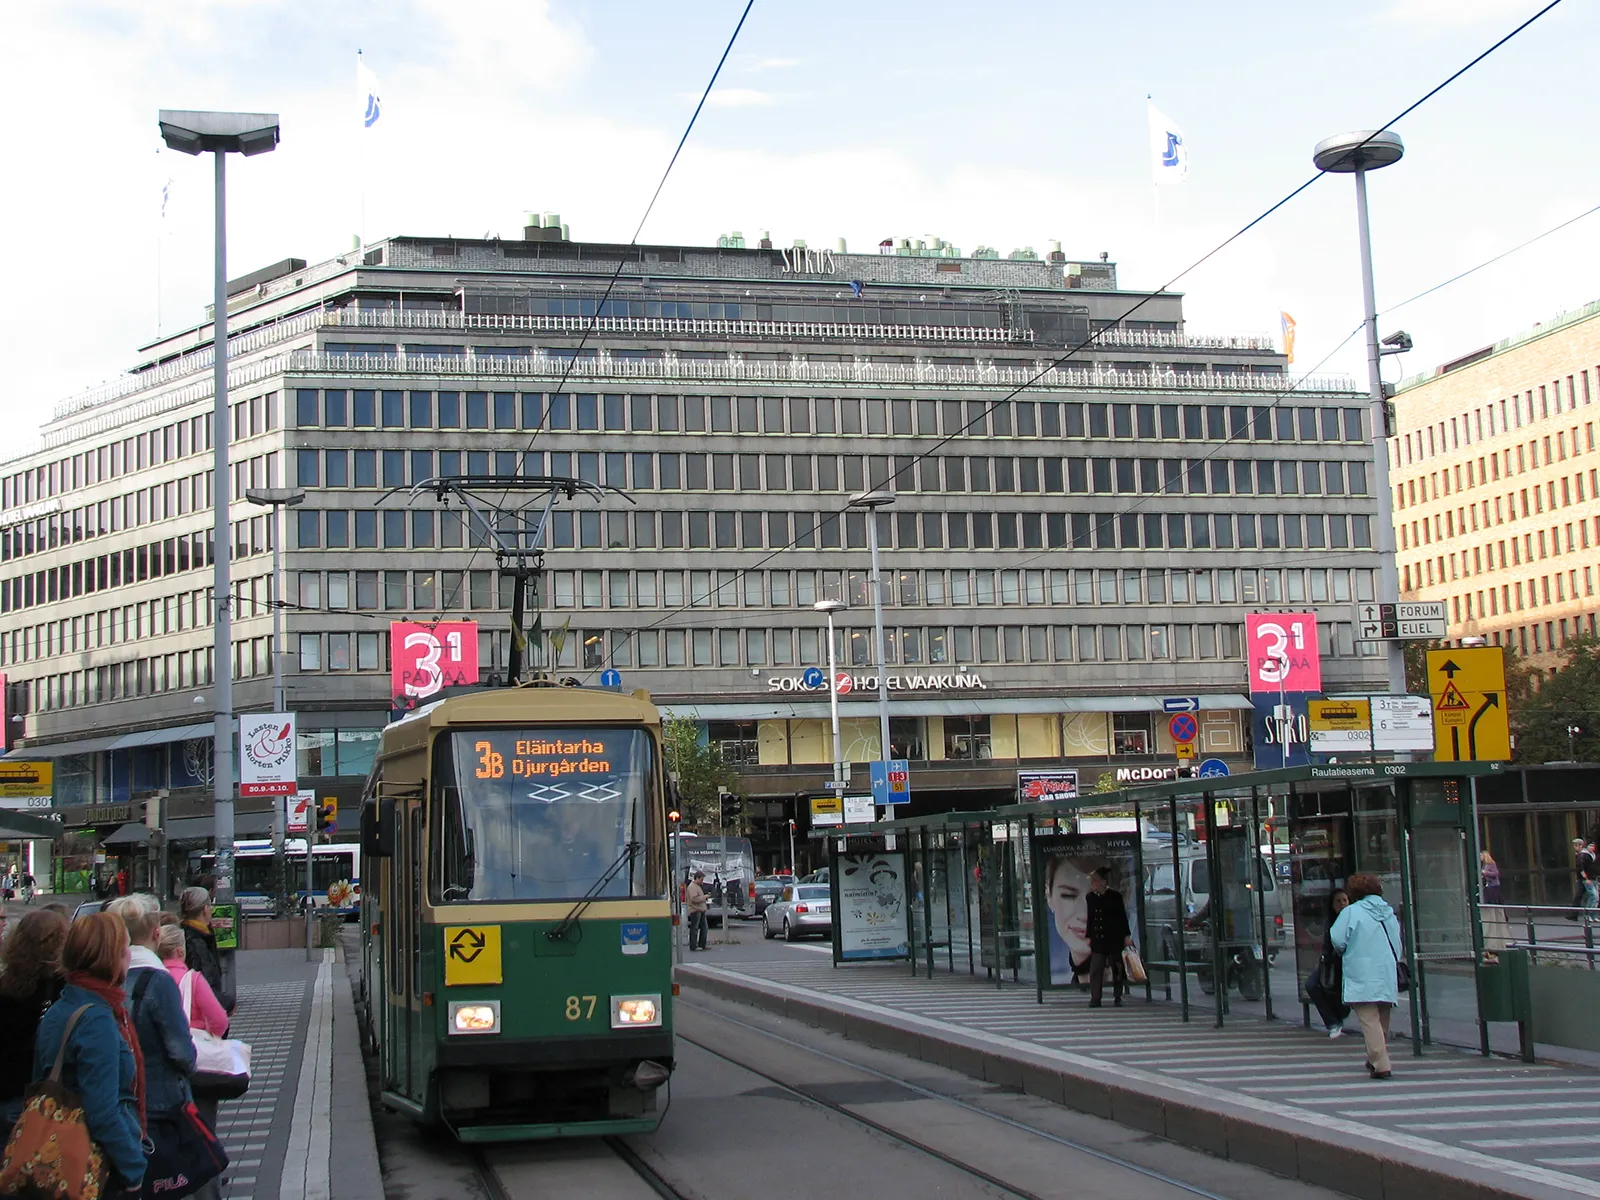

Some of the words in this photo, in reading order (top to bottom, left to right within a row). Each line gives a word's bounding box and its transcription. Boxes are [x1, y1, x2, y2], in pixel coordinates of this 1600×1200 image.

[782, 247, 835, 274] SOKOS
[1400, 605, 1439, 617] FORUM
[1402, 622, 1432, 634] ELIEL
[854, 675, 905, 691] HOEL
[247, 723, 279, 738] Lasten
[1381, 720, 1387, 729] 6
[1347, 731, 1370, 741] 0302
[516, 740, 603, 755] Eläintarha
[245, 743, 273, 769] Nuorten
[475, 741, 504, 779] 3B
[512, 758, 610, 777] Djurgården
[1311, 767, 1375, 778] Rautatieasema
[1384, 765, 1406, 775] 0302
[894, 783, 903, 791] 51
[1054, 792, 1076, 800] SHOW
[565, 995, 597, 1021] 87
[152, 1173, 188, 1194] FILA
